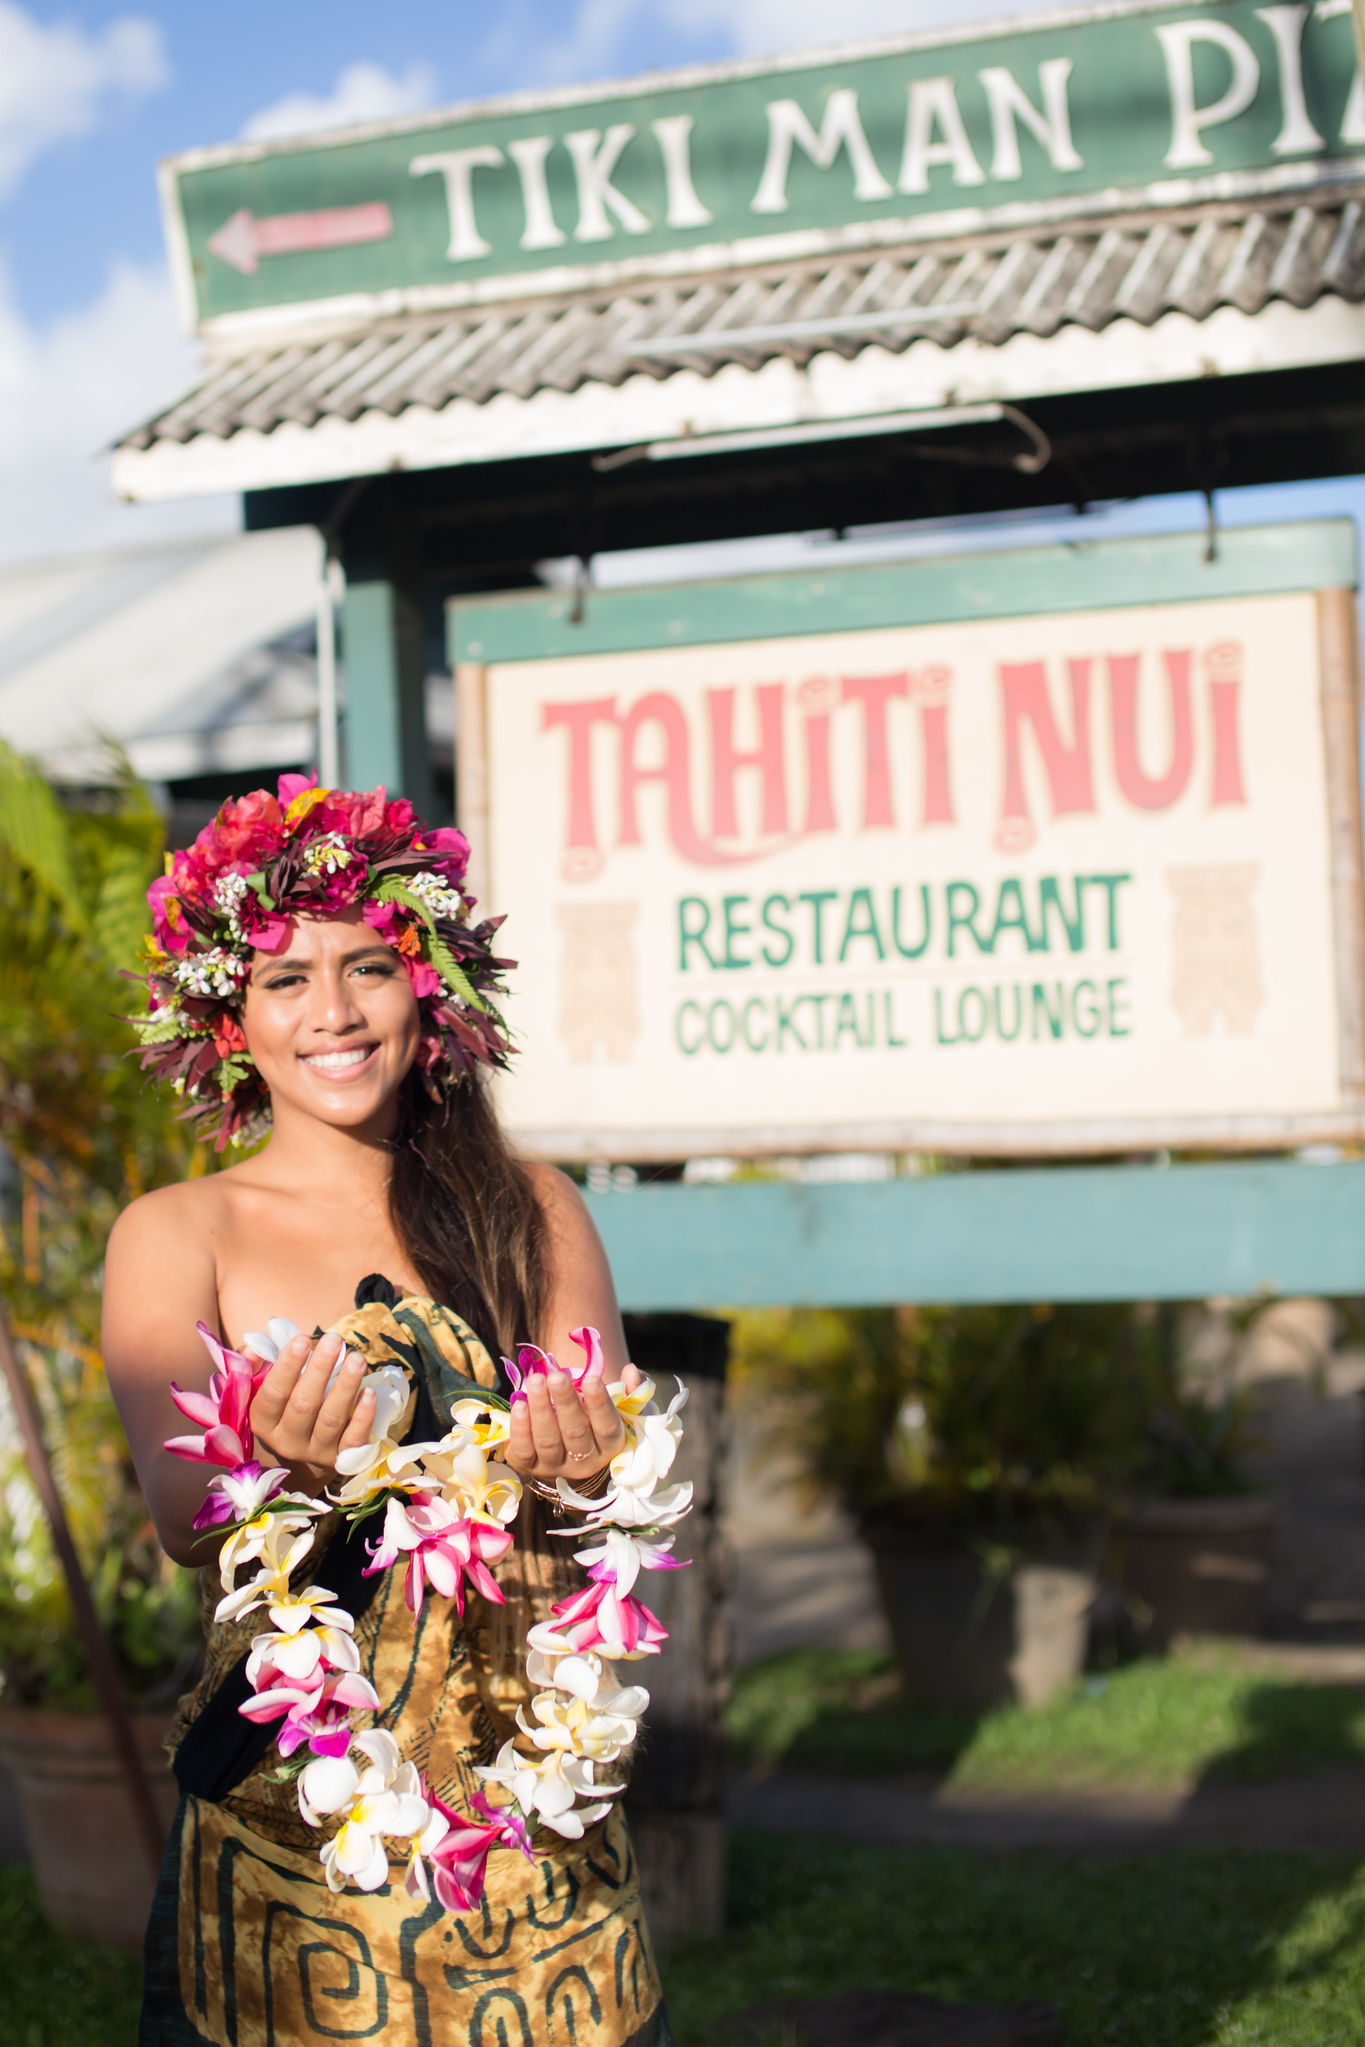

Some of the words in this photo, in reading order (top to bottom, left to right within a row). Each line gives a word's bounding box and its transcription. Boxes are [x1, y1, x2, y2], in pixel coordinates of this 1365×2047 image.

[409, 116, 711, 260] TIKI
[751, 58, 1084, 213] MAN
[677, 872, 1131, 973] RESTAURANT
[676, 990, 907, 1056] COCKTAIL
[934, 979, 1131, 1045] LOUNGE
